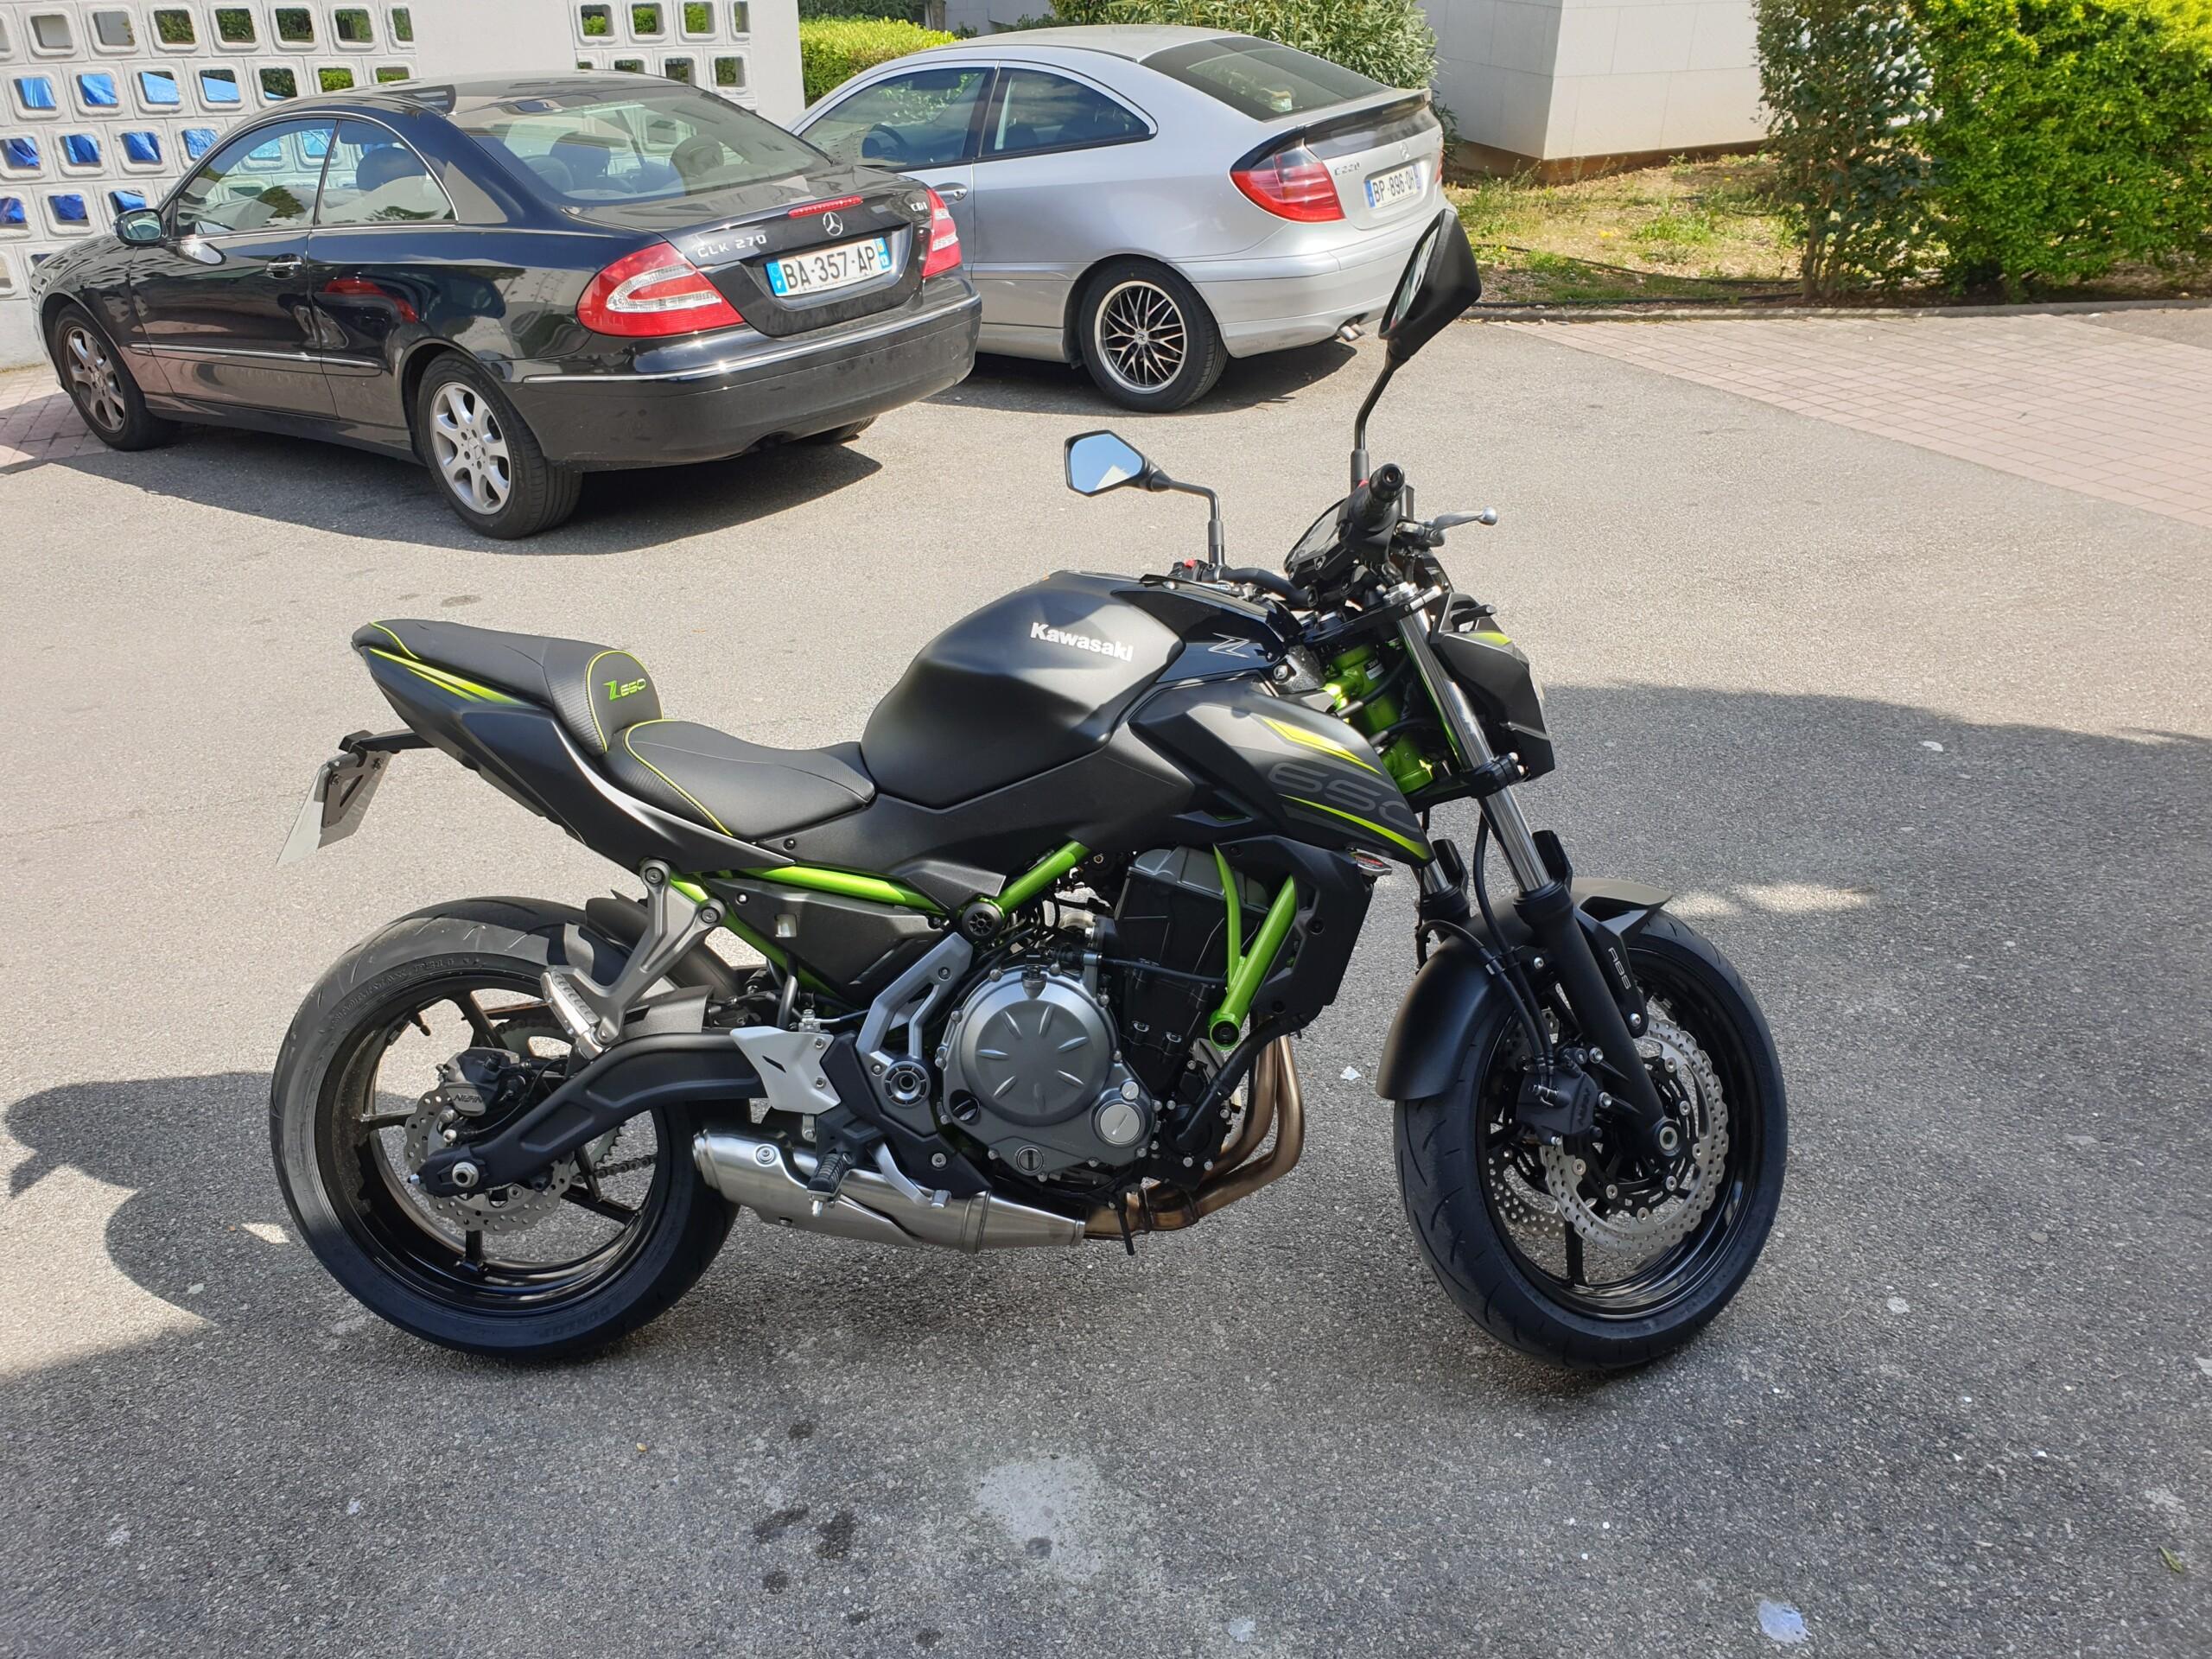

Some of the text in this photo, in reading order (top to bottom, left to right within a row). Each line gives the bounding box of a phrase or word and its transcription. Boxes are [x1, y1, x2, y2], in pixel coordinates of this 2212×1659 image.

[697, 234, 767, 258] CLK 270
[782, 244, 876, 289] BA-357-AP
[1030, 622, 1135, 662] Kawasaki
[602, 678, 647, 701] Z650
[1608, 947, 1631, 989] ABS
